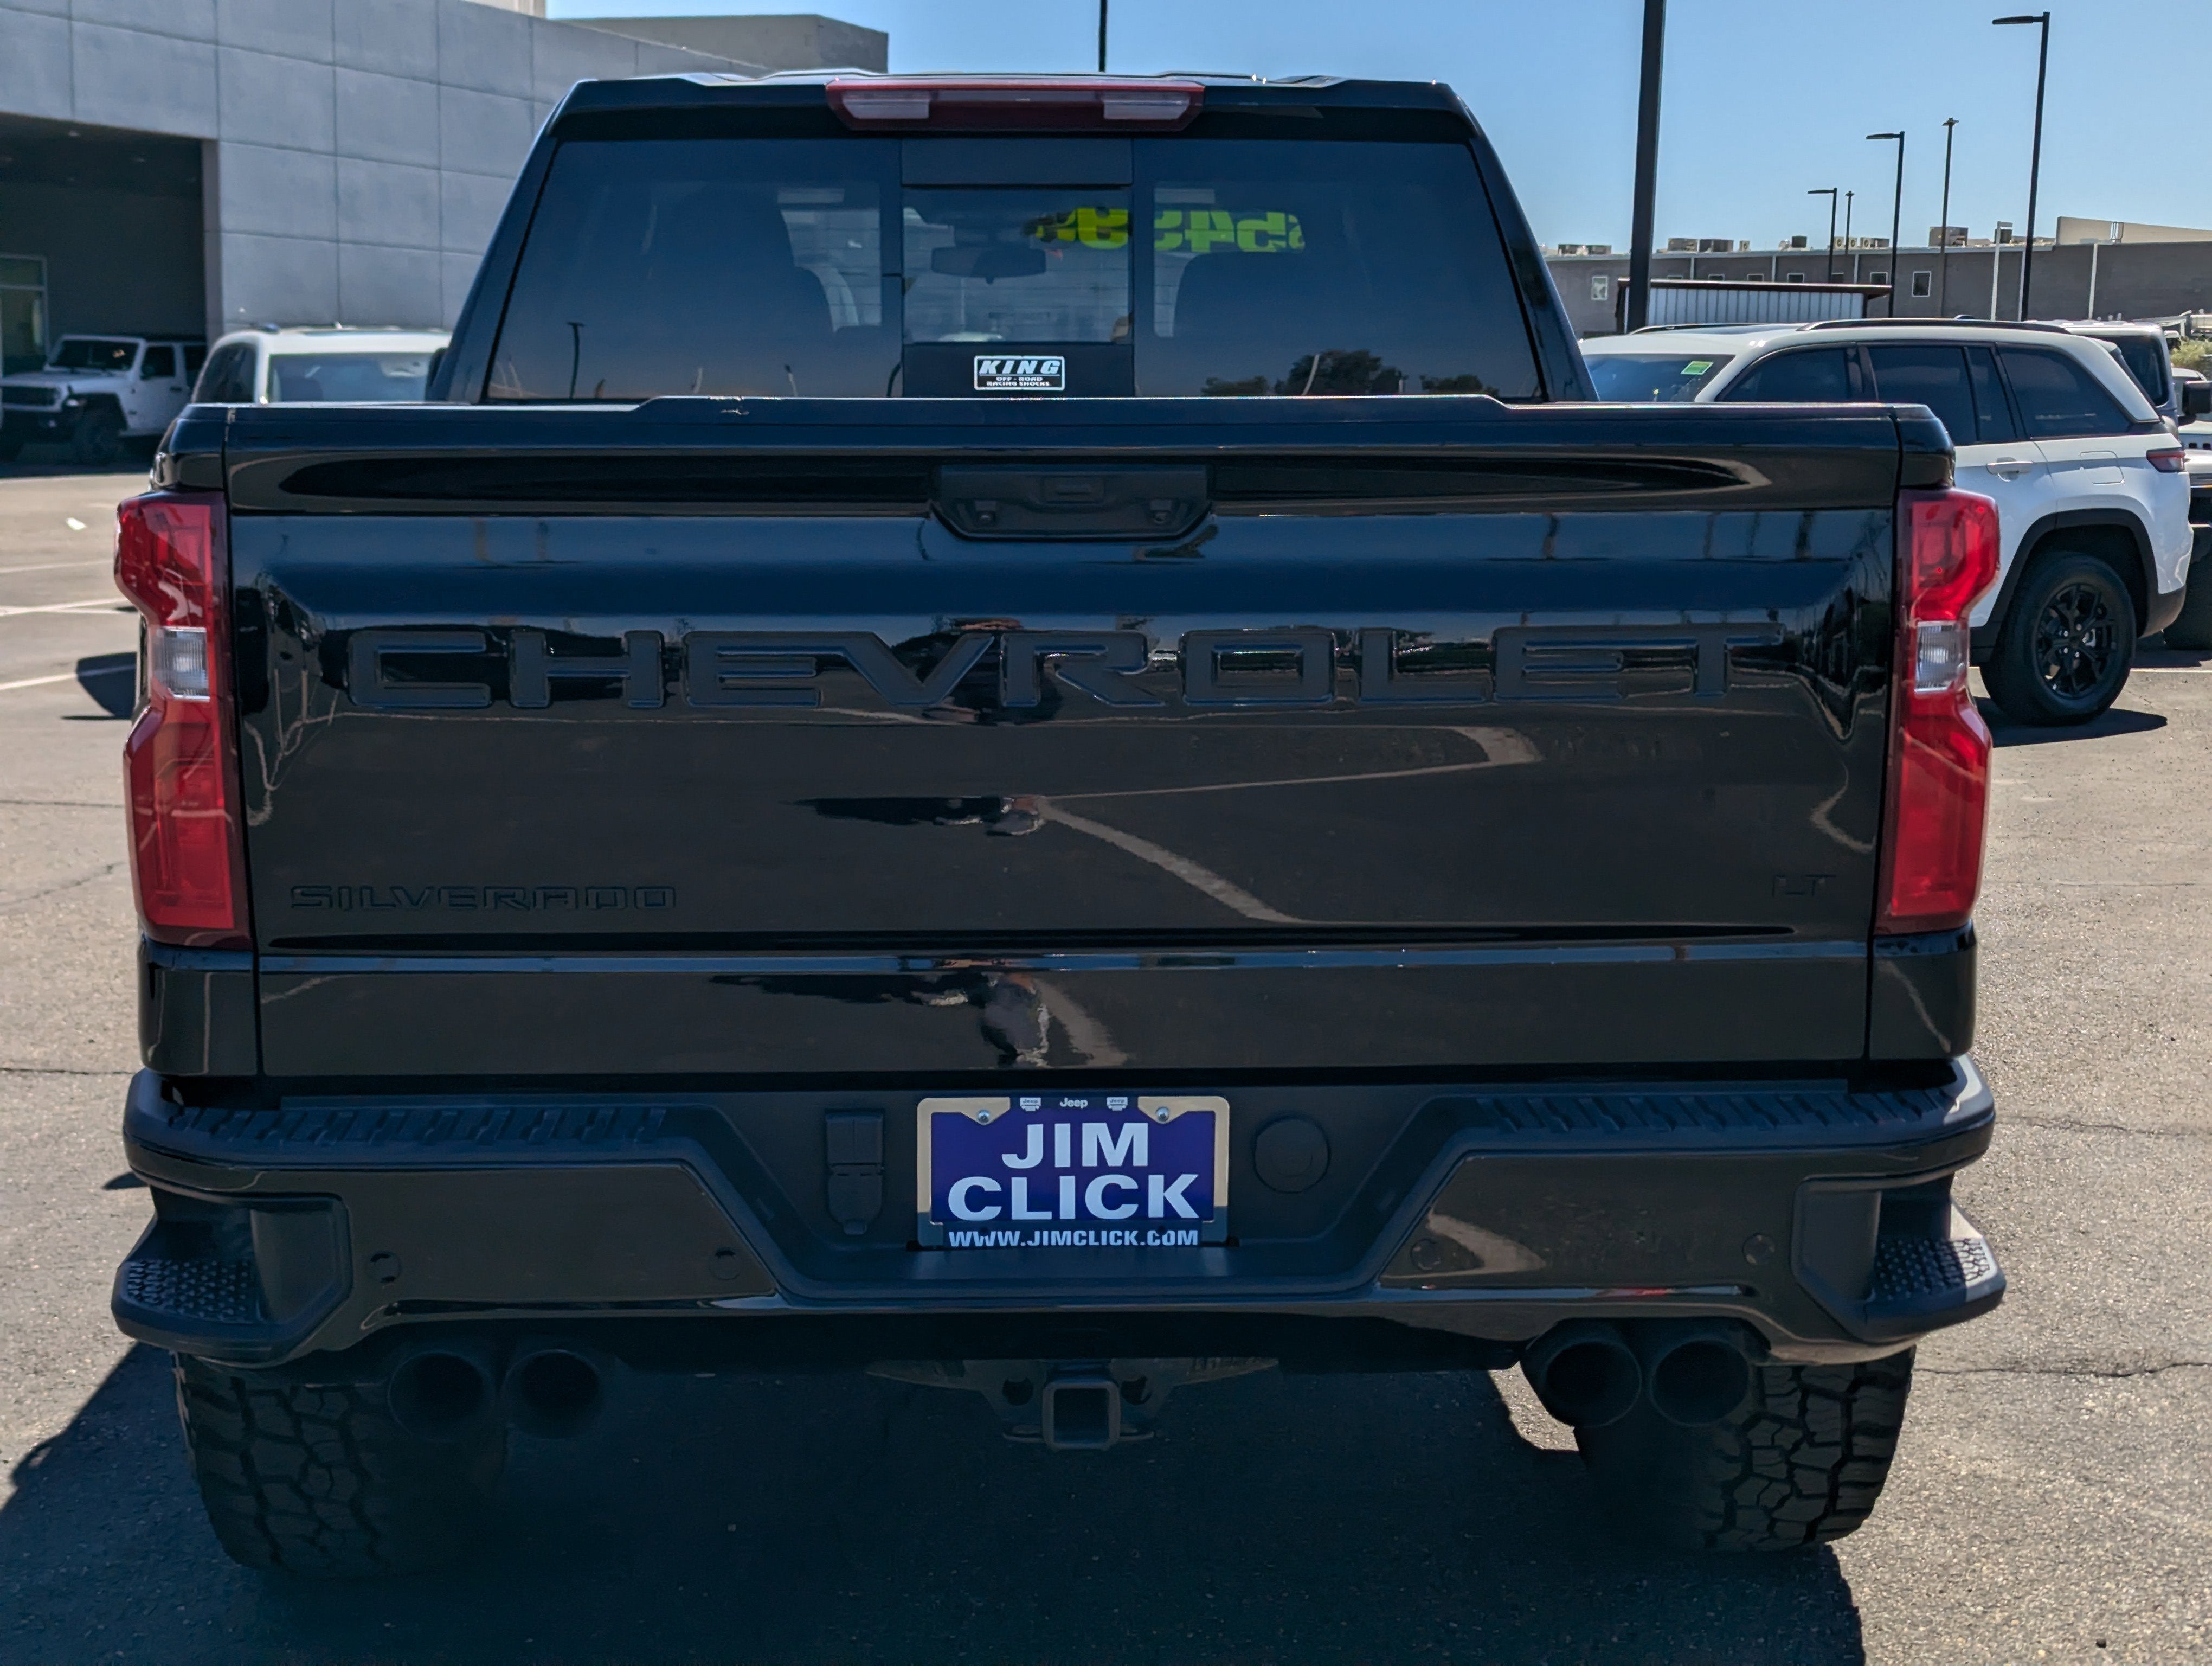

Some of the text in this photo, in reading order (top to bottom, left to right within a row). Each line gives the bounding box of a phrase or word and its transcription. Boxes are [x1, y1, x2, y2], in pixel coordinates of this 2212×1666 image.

[979, 360, 1060, 374] KING
[347, 622, 1787, 709] CHEVROLET
[291, 885, 677, 911] SILVERADO
[1771, 872, 1837, 899] LT
[1059, 1097, 1088, 1109] Jeep
[1001, 1122, 1149, 1169] JIM
[948, 1174, 1199, 1221] CLICK
[948, 1229, 1199, 1247] WWW.JIMCLICK.COM
